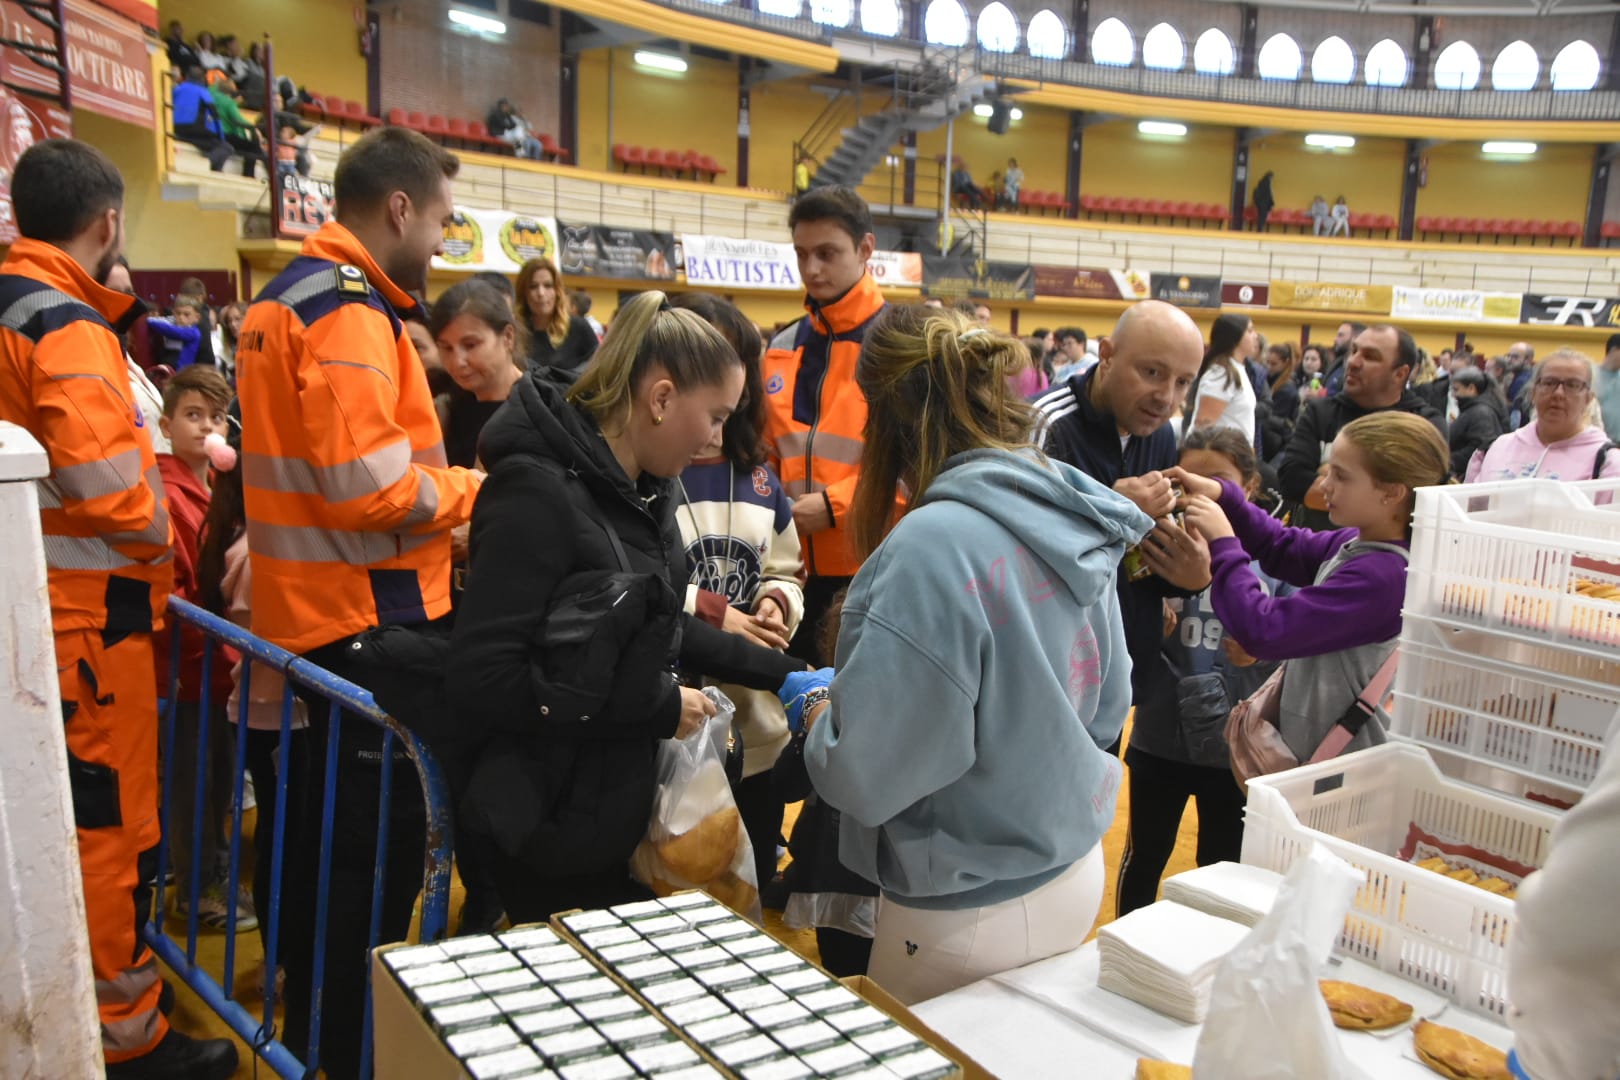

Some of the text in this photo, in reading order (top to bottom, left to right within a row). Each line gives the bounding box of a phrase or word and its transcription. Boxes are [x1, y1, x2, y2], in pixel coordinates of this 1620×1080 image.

[66, 43, 149, 101] OCTUBRE
[687, 256, 796, 284] BAUTISTA
[1180, 617, 1223, 650] 09
